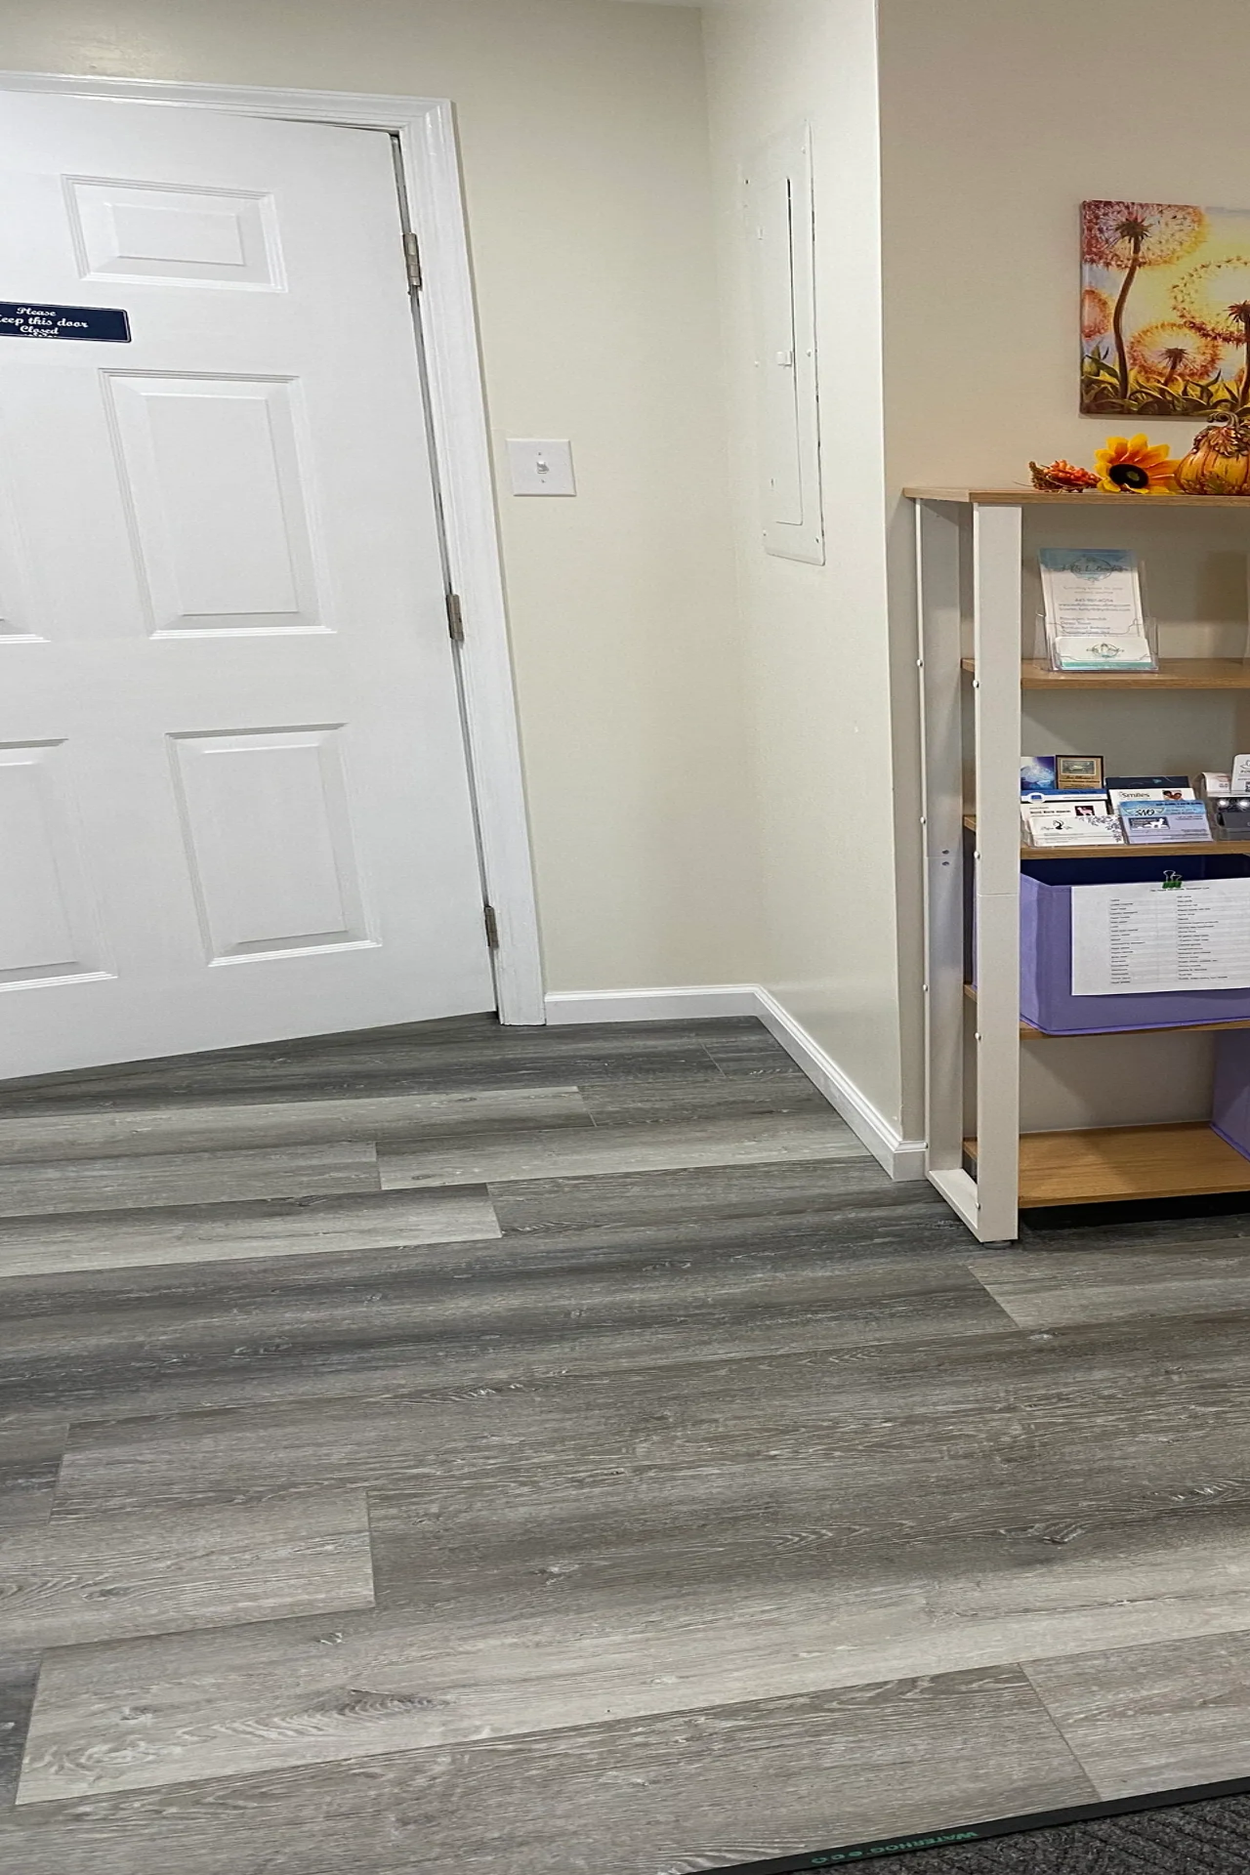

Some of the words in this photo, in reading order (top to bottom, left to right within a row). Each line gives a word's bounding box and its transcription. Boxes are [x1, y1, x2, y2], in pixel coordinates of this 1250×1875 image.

[16, 307, 57, 317] Please
[0, 314, 24, 326] eep
[28, 317, 53, 326] this
[57, 318, 88, 328] door
[20, 325, 59, 335] Closed
[871, 1832, 979, 1855] WATERHOG
